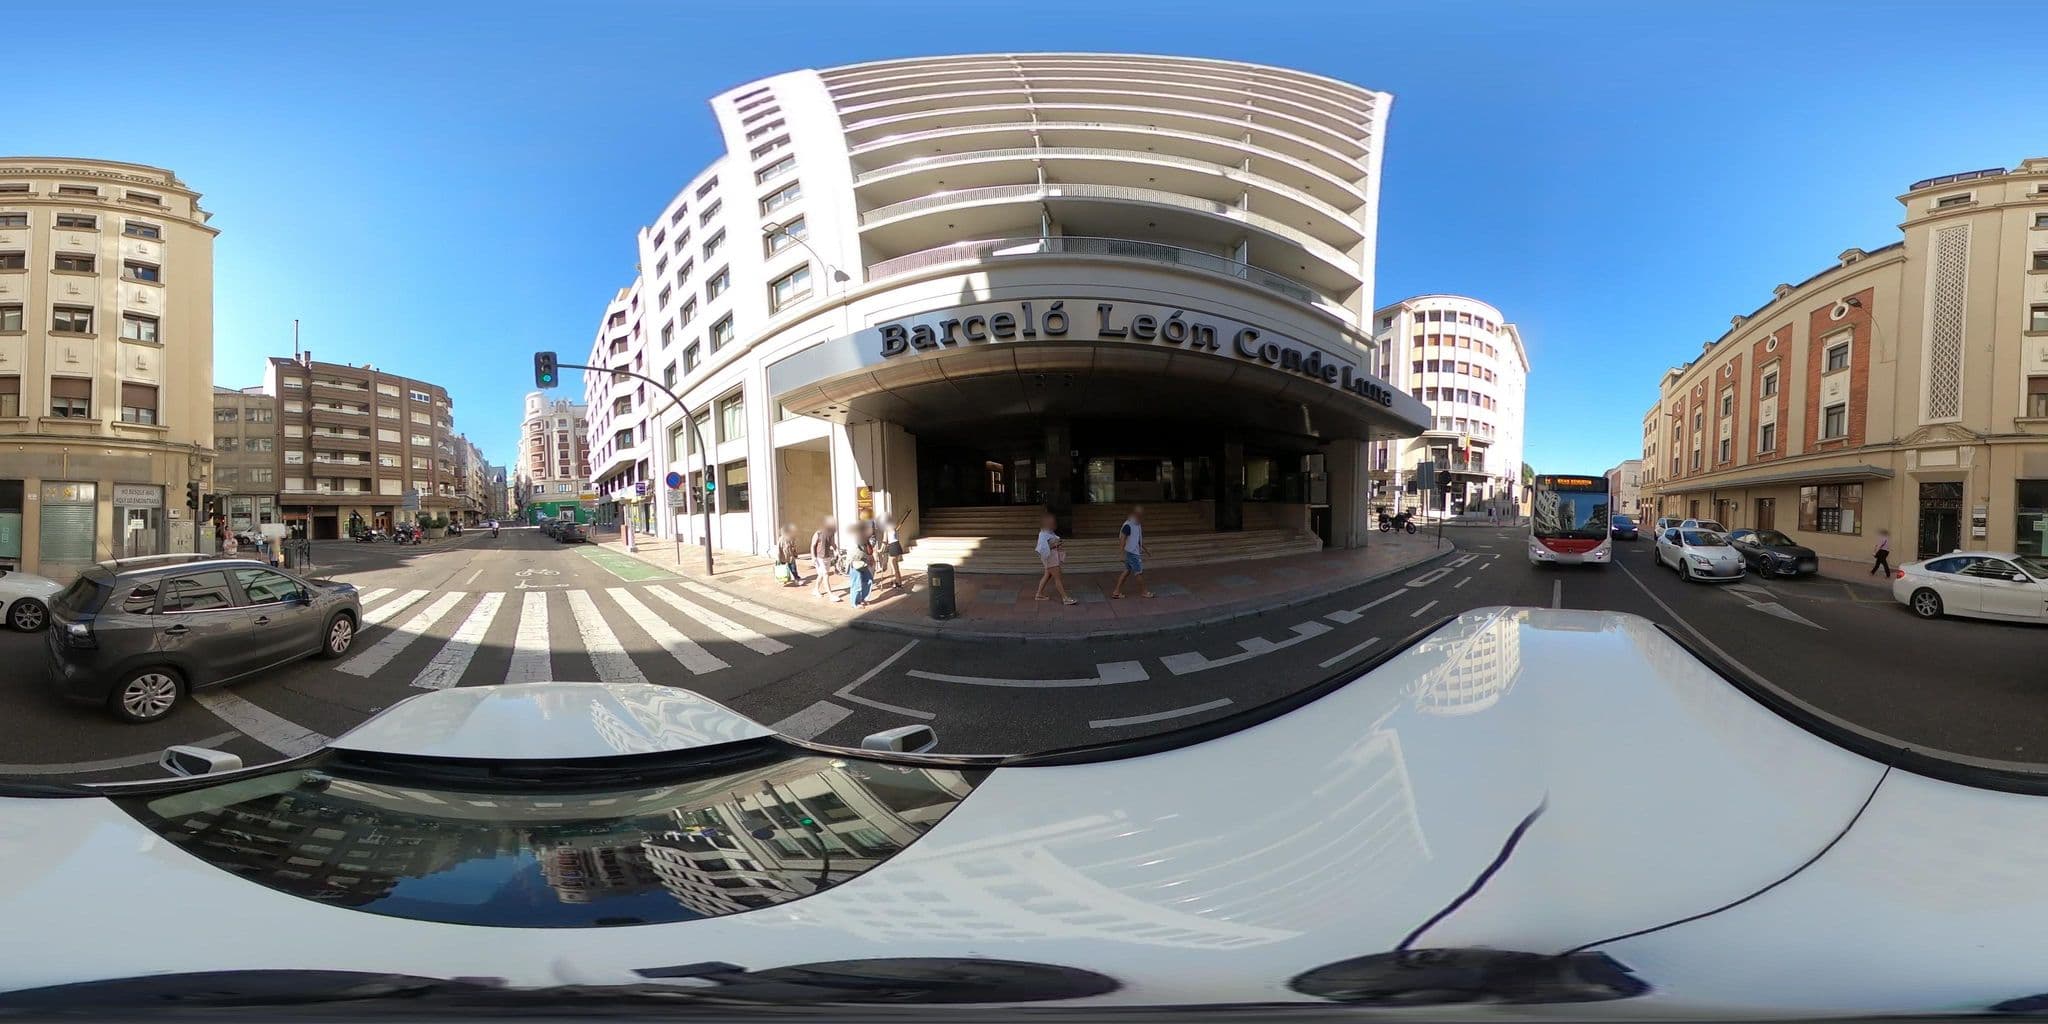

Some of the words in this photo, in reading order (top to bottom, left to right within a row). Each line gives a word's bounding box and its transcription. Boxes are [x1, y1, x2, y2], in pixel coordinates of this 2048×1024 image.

[878, 301, 1070, 357] Barceló
[1097, 303, 1219, 350] León
[1233, 327, 1338, 384] Conde
[1341, 365, 1393, 407] Luna
